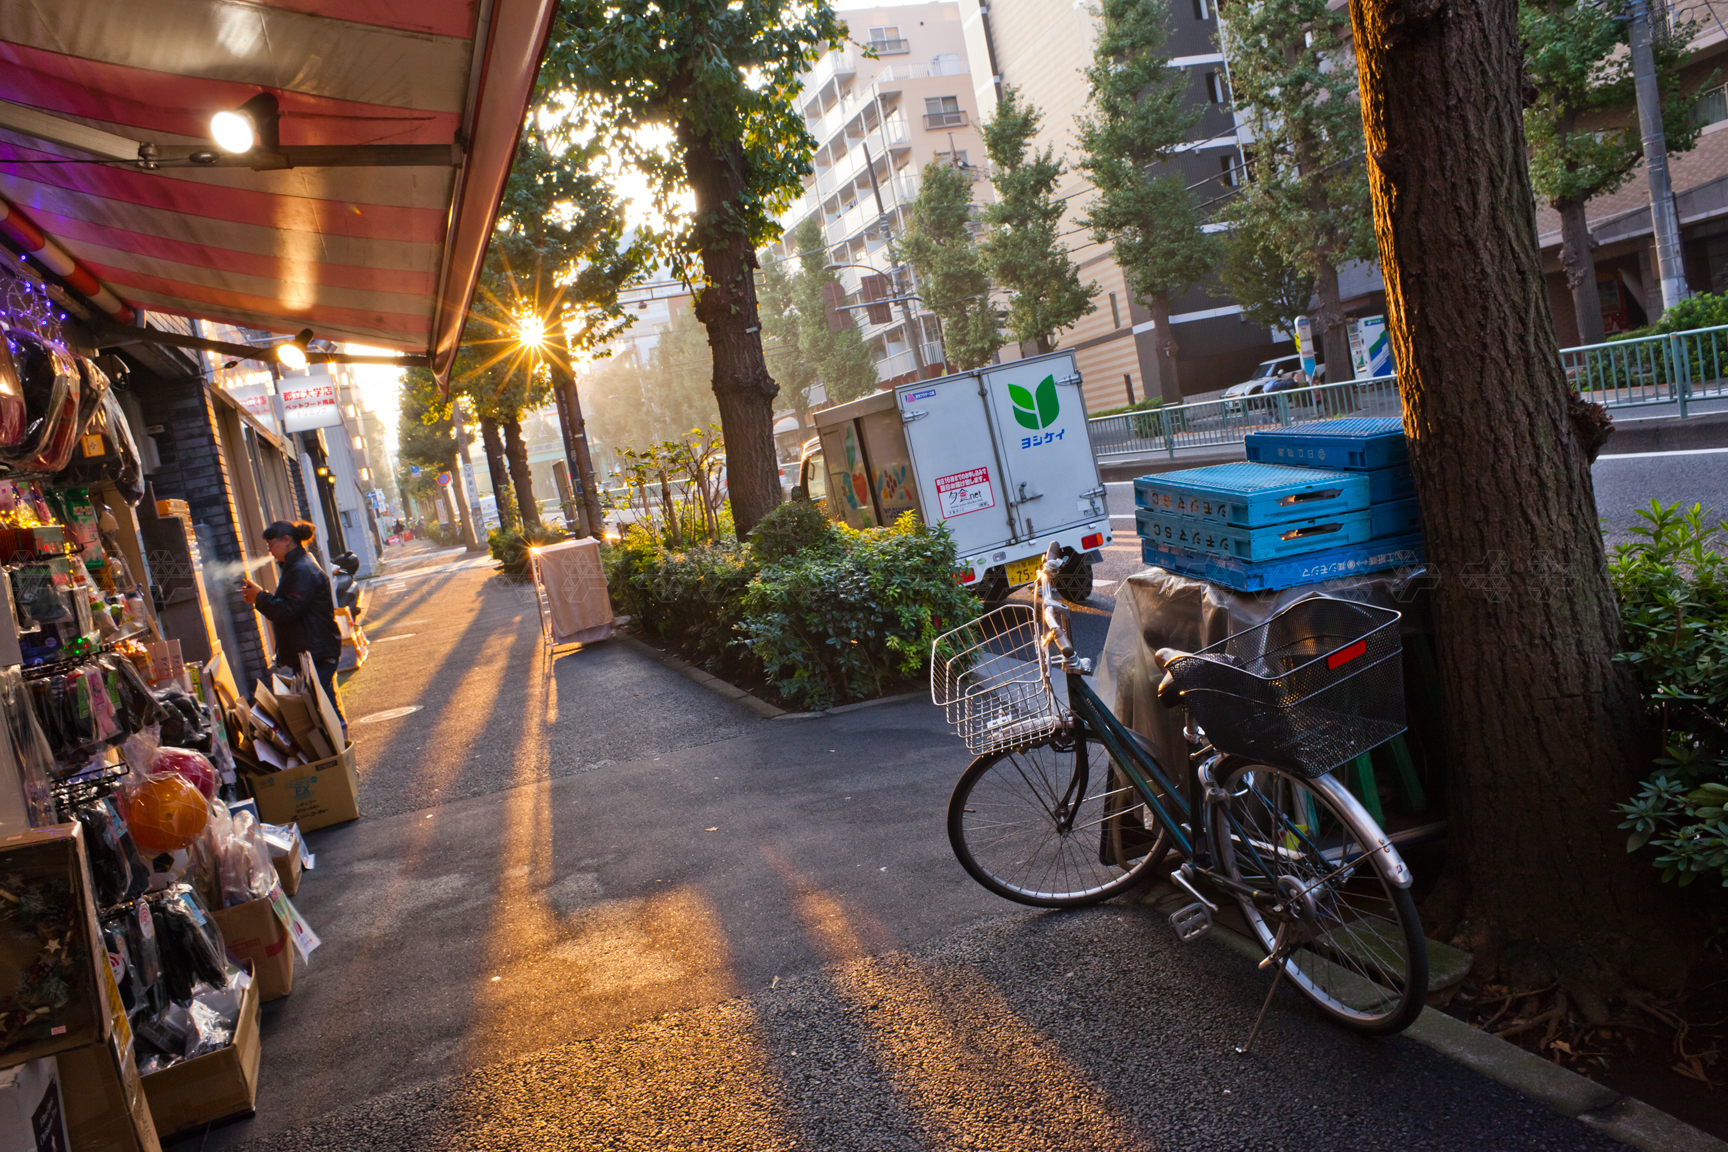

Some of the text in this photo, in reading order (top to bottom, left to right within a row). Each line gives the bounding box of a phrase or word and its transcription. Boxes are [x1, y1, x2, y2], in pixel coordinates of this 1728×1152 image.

[283, 385, 333, 402] 都立大学店
[284, 398, 335, 410] ペットフード用品
[296, 407, 327, 417] トリミング
[1021, 428, 1066, 450] ヨシケイ
[1152, 492, 1227, 518] シモジマ SC
[1153, 523, 1229, 551] シモジマ SC
[295, 785, 310, 797] EX
